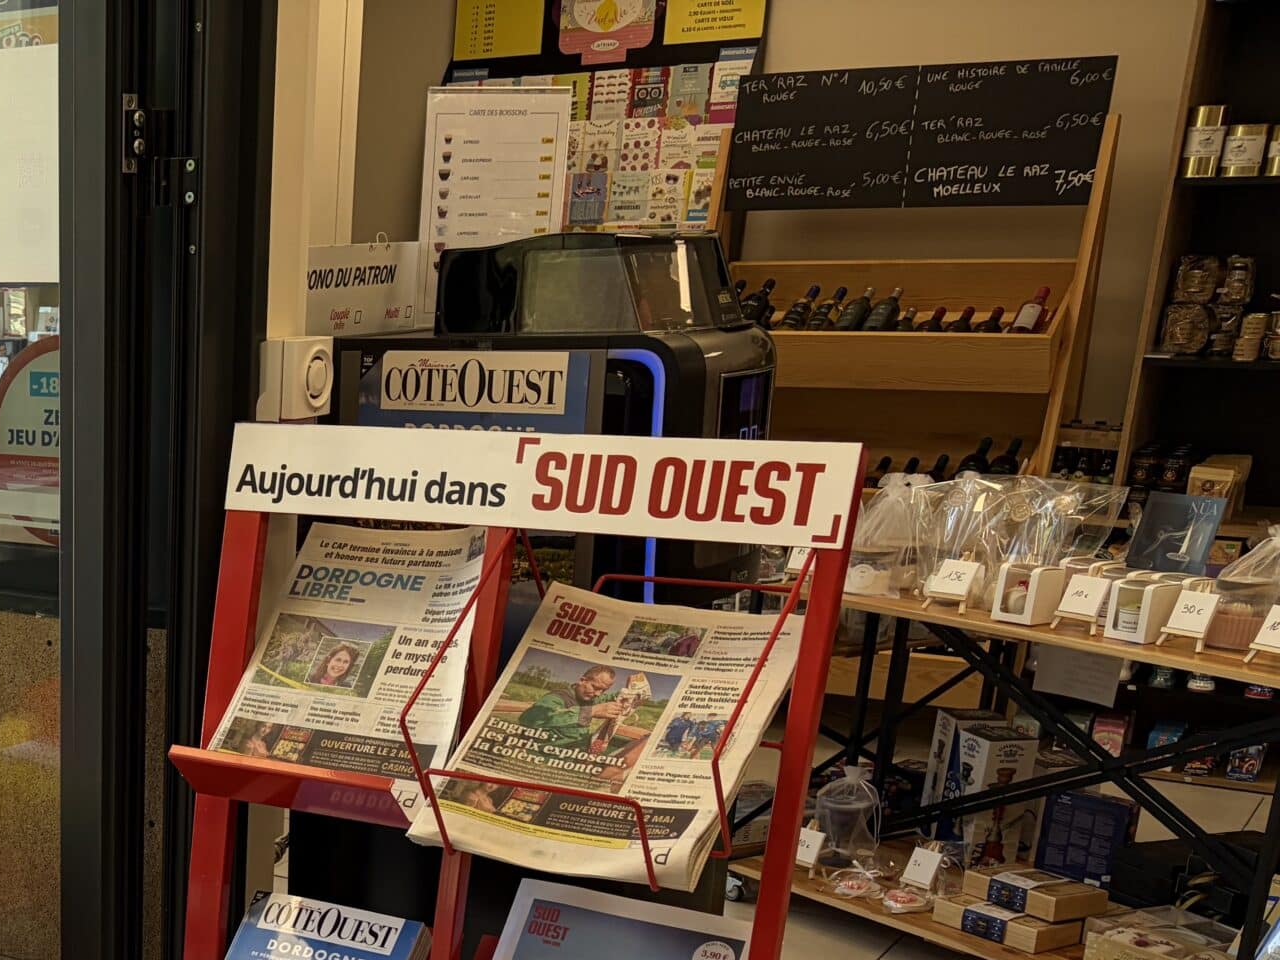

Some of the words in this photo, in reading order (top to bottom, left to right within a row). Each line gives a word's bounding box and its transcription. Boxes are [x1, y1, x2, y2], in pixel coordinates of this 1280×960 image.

[926, 71, 950, 83] UNE
[957, 65, 1008, 78] HISTOIRE
[1016, 64, 1030, 75] DE
[949, 80, 985, 93] ROUGE
[762, 91, 798, 103] ROUGE
[734, 126, 792, 145] CHATEAU
[800, 125, 816, 136] LE
[729, 175, 763, 189] PETITE
[769, 173, 806, 187] ENVIE
[914, 165, 989, 183] CHATEAU
[999, 164, 1016, 178] LE
[1023, 163, 1050, 177] RAZ
[933, 183, 1002, 198] MOELLEUX
[307, 270, 333, 291] ONO
[335, 268, 351, 288] DU
[353, 264, 398, 286] PATRON
[384, 306, 401, 320] Multi
[7, 428, 36, 446] JEU
[235, 462, 419, 506] Aujourd'hui
[424, 469, 507, 508] dans
[531, 451, 639, 516] SUD
[647, 456, 826, 526] OUEST
[320, 540, 330, 549] Le
[332, 541, 348, 551] CAP
[349, 544, 381, 554] termine
[382, 545, 416, 556] invaincu
[426, 548, 434, 556] la
[437, 547, 463, 557] maison
[324, 552, 333, 560] et
[335, 552, 363, 562] honore
[365, 556, 379, 564] ses
[381, 556, 406, 566] futurs
[296, 564, 426, 592] DORDOGNE
[289, 581, 353, 601] LIBRE
[556, 601, 598, 626] SUD
[546, 618, 609, 648] OUEST
[320, 739, 376, 754] OUVERTURE
[377, 746, 388, 756] LE
[389, 747, 397, 757] 2
[473, 738, 490, 752] la
[492, 744, 546, 765] colère
[547, 758, 603, 776] monte
[480, 728, 504, 742] les
[505, 735, 542, 752] prix
[543, 744, 628, 769] explosent,
[381, 762, 415, 775] CASINO
[560, 801, 625, 819] OUVERTURE
[532, 904, 561, 923] SUD
[527, 920, 570, 942] OUEST
